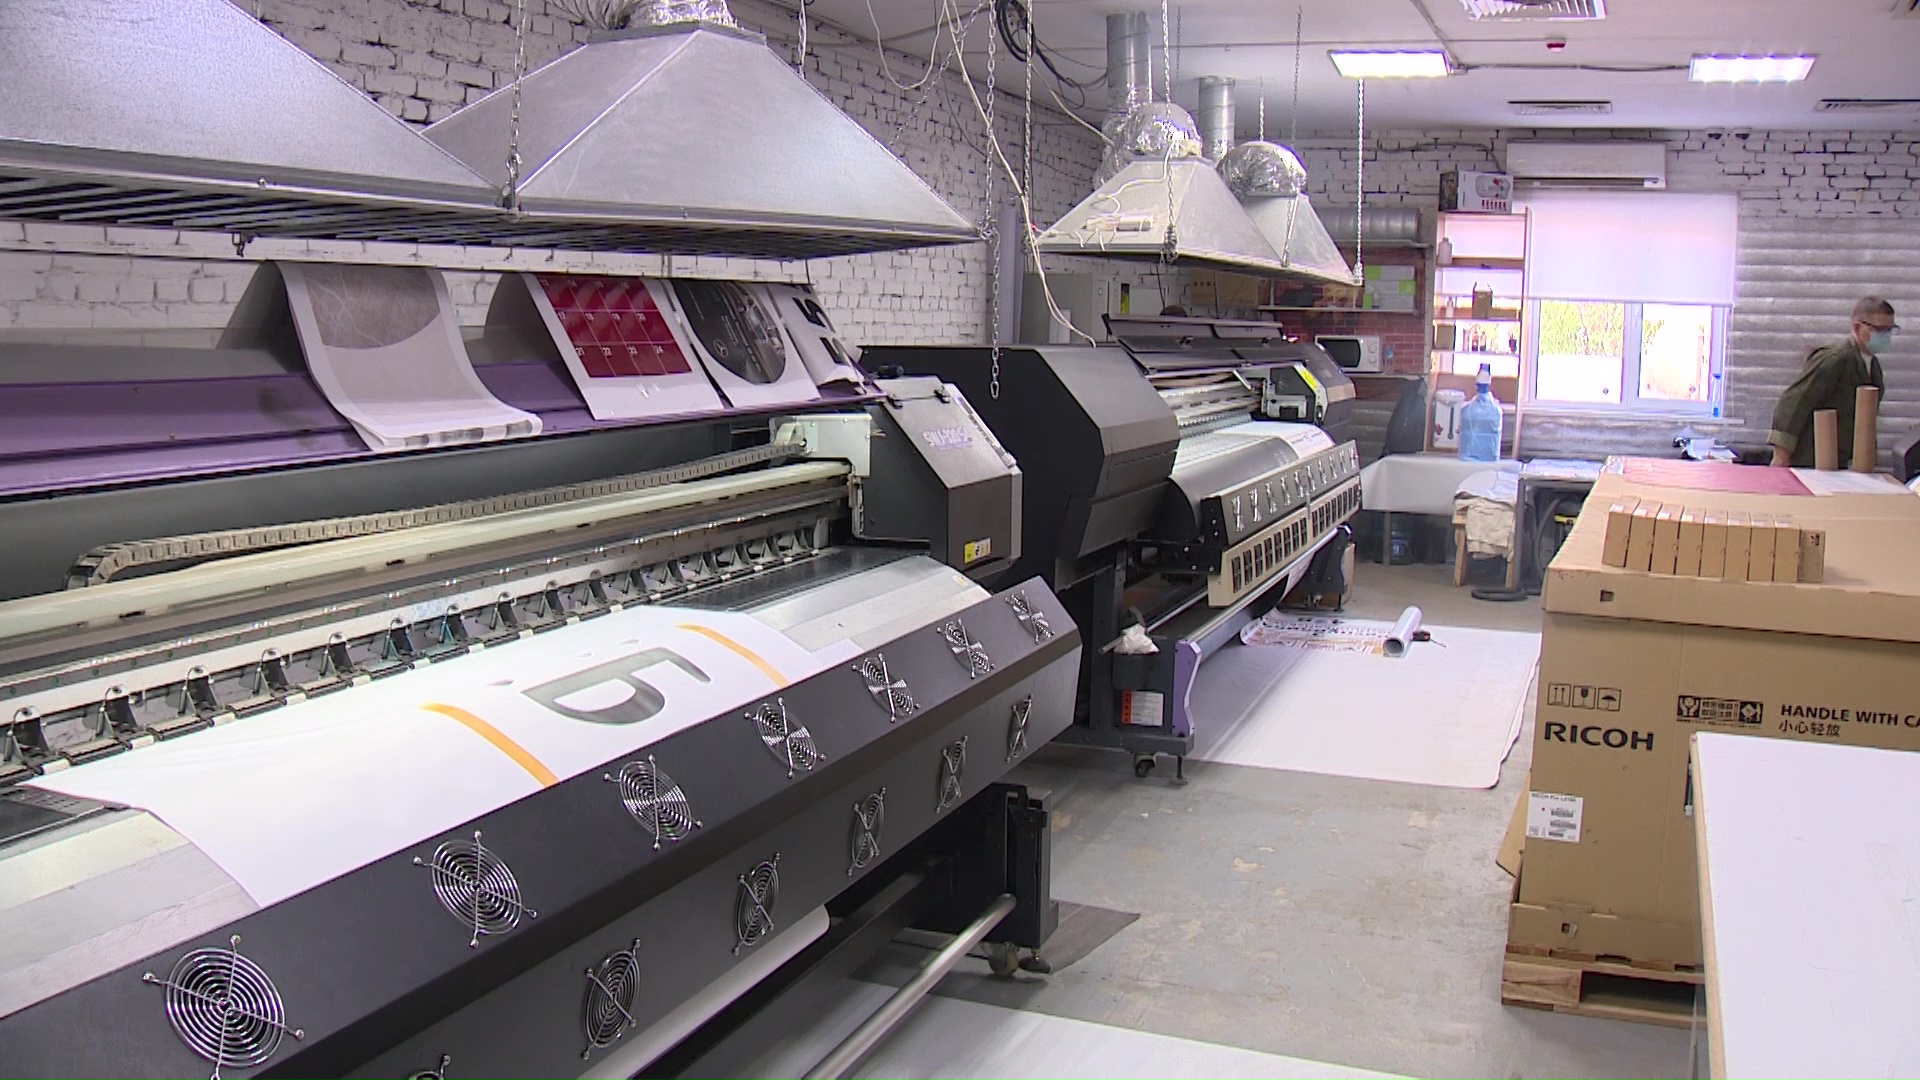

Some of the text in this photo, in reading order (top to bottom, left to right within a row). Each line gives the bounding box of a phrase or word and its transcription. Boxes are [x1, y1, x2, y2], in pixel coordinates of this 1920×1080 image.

[1781, 704, 1850, 722] HANDLE
[1856, 711, 1898, 726] WITH
[1544, 721, 1654, 750] RICOH
[1779, 719, 1841, 737] 小心轻放
